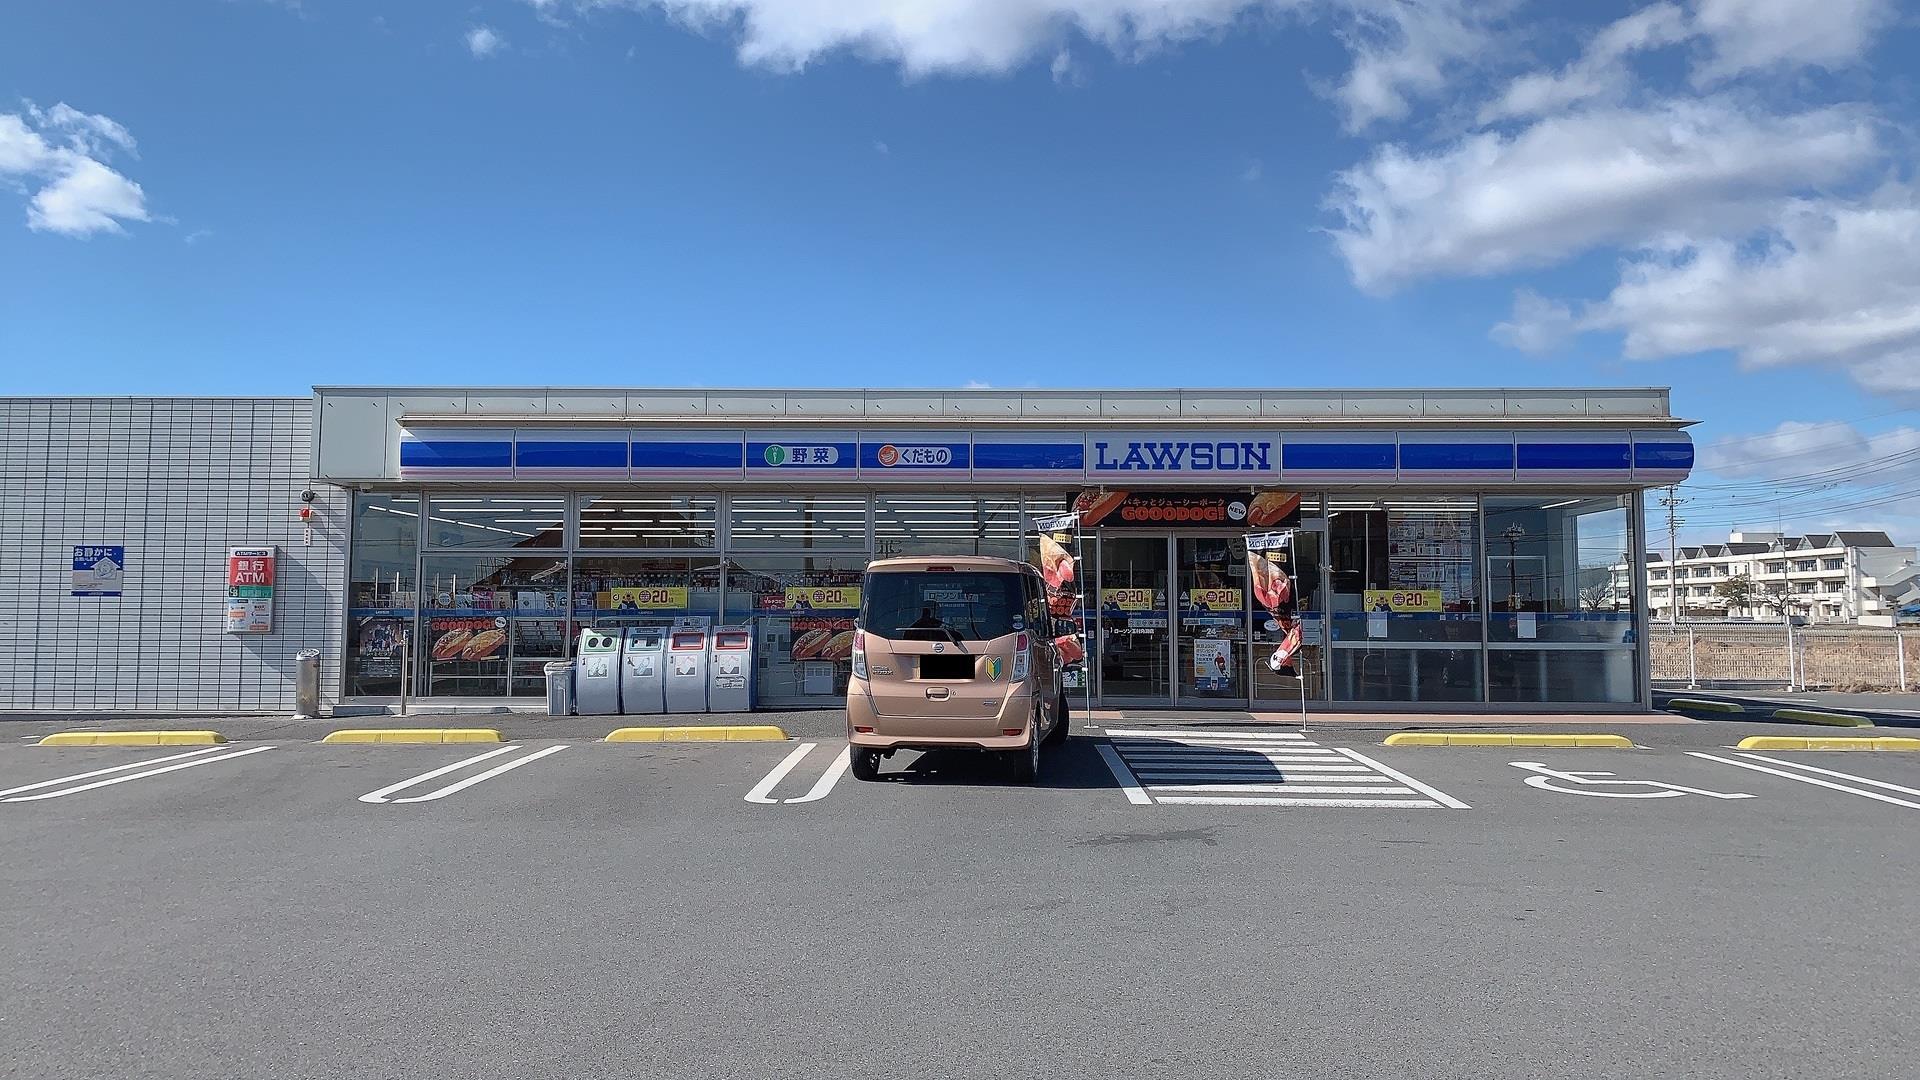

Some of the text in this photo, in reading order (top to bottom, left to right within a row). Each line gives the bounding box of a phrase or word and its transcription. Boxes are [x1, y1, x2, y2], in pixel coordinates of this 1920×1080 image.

[792, 447, 829, 463] 野菜
[901, 448, 949, 464] くだもの
[1095, 442, 1271, 470] LAWSON
[1121, 506, 1225, 521] GOOODOG!
[1228, 505, 1246, 516] NEW
[237, 560, 265, 571] 銀行
[234, 572, 265, 583] ATM
